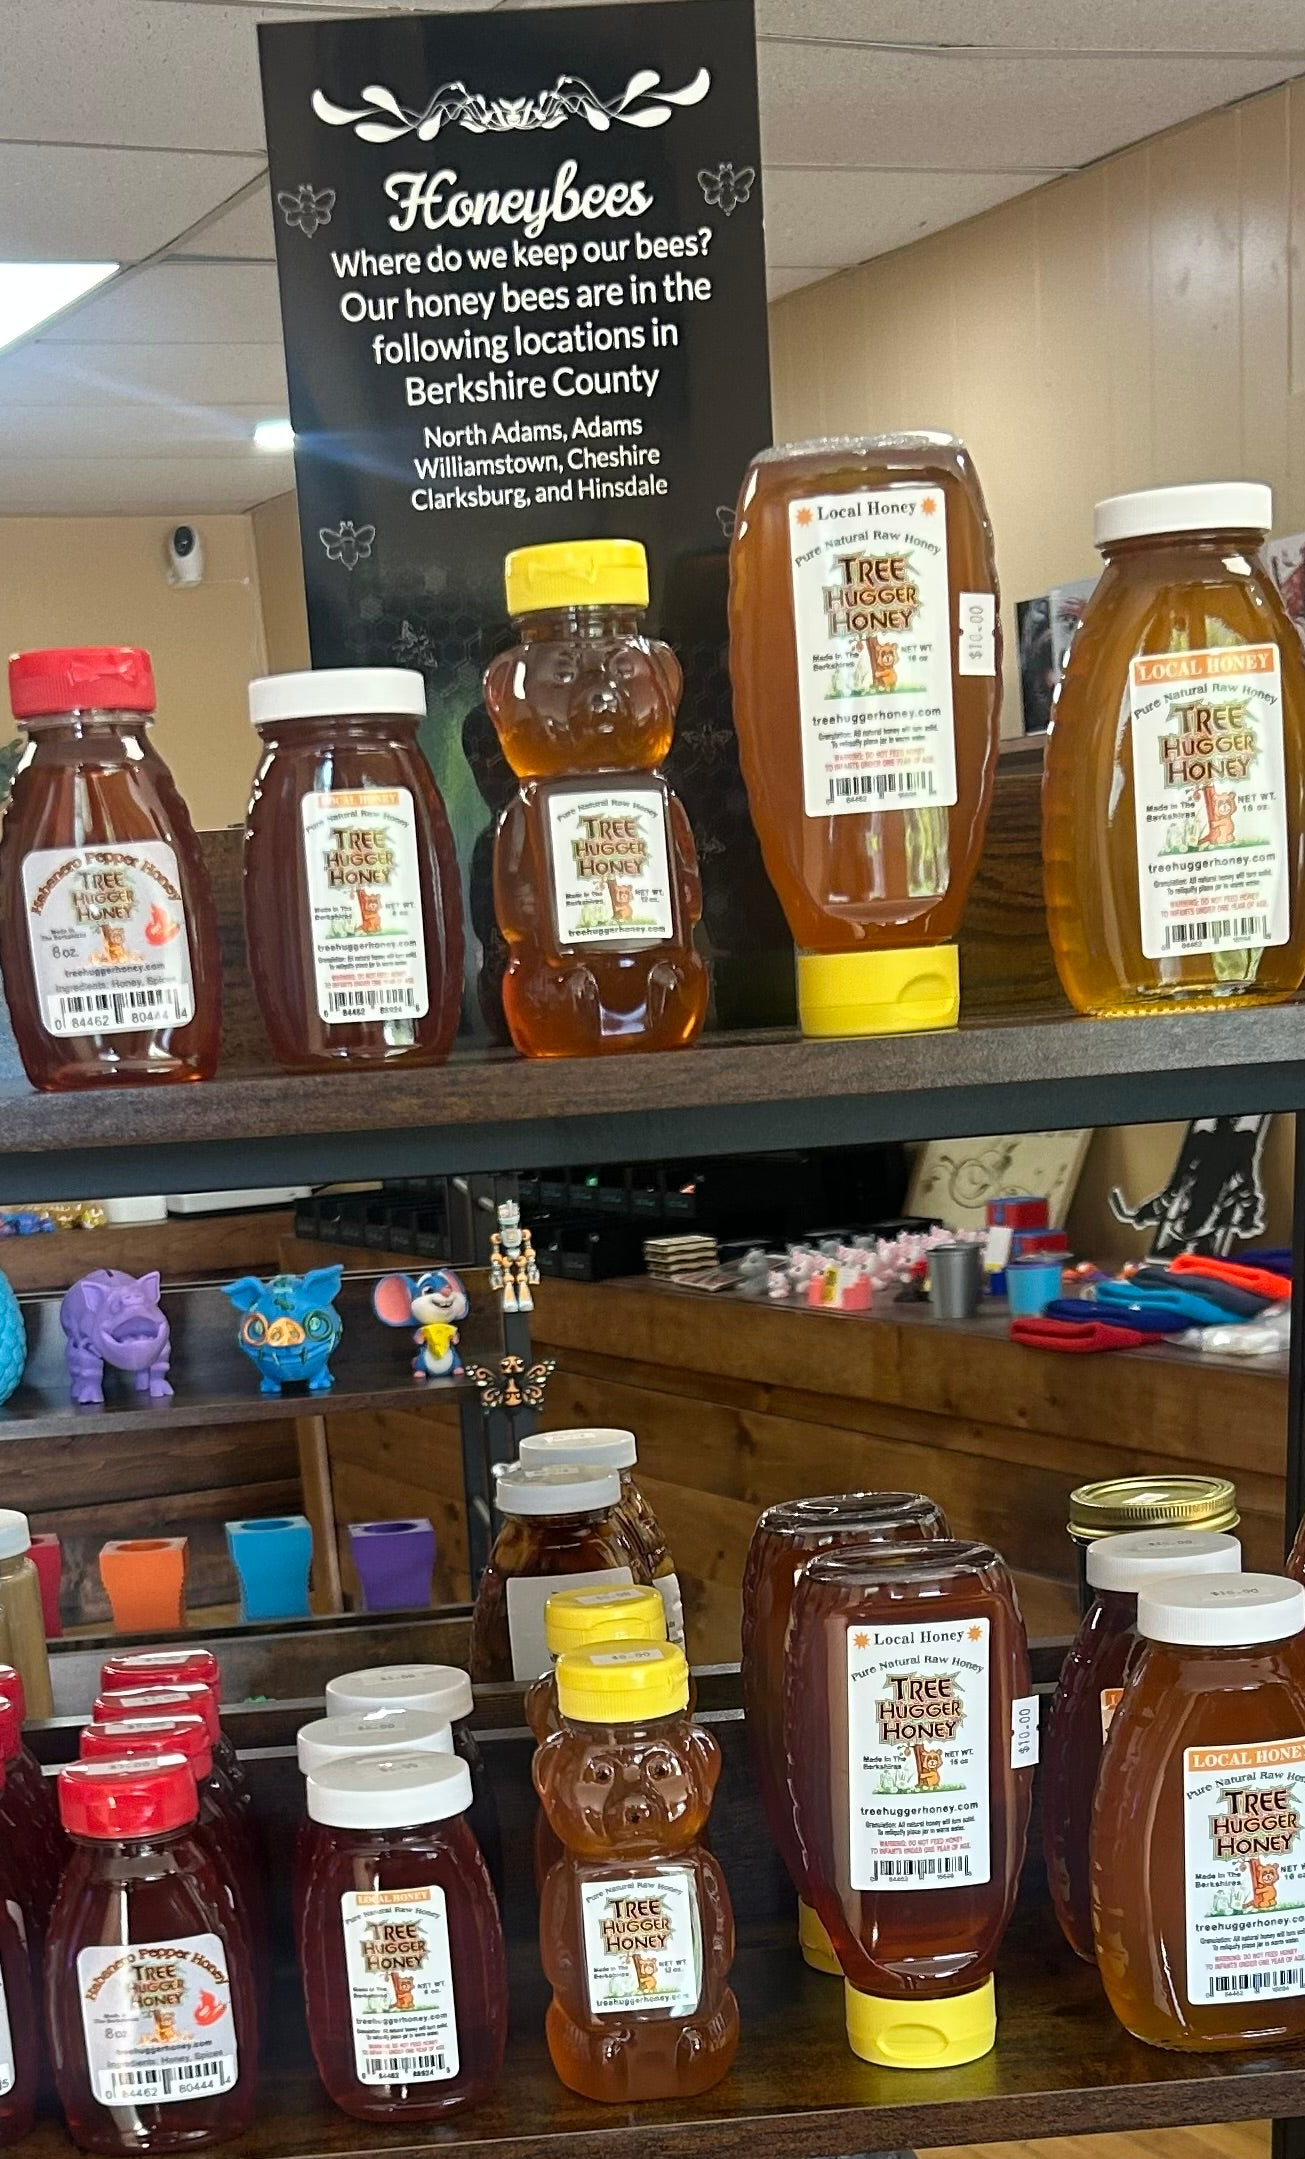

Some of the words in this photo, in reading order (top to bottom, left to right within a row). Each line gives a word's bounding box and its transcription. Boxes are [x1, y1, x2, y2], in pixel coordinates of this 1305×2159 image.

[383, 158, 653, 239] Honeybees
[331, 247, 421, 280] Where
[427, 245, 463, 273] do
[467, 247, 507, 270] we
[513, 238, 577, 270] keep
[582, 238, 630, 263] our
[634, 227, 713, 259] bees?
[340, 292, 399, 323] Our
[405, 287, 495, 321] honey
[503, 282, 570, 312] bees
[575, 282, 623, 307] are
[629, 276, 657, 304] in
[663, 273, 712, 301] the
[372, 329, 509, 365] following
[514, 322, 645, 355] locations
[651, 318, 679, 346] in
[405, 371, 547, 406] Berkshire
[552, 365, 659, 398] County
[423, 424, 488, 448] North
[491, 419, 568, 444] Adams,
[572, 415, 643, 438] Adams
[414, 451, 564, 479] Williamstown,
[567, 446, 660, 470] Cheshire
[411, 485, 532, 511] Clarksburg,
[535, 480, 573, 503] and
[578, 476, 668, 500] Hinsdale
[818, 502, 862, 521] Local
[868, 501, 917, 516] Honey
[795, 547, 822, 568] Pure
[825, 530, 869, 550] Natural
[873, 530, 901, 541] Raw
[904, 533, 942, 555] Honey
[838, 557, 905, 586] TREE
[828, 587, 917, 610] HUGGER
[833, 611, 913, 633] HONEY
[969, 605, 984, 659] $10.00
[1139, 660, 1202, 681] LOCAL
[1207, 653, 1270, 673] HONEY
[1134, 700, 1161, 720] Pure
[1164, 683, 1208, 703] Natural
[1212, 683, 1238, 693] Raw
[1242, 685, 1278, 706] Honey
[812, 708, 941, 726] treehuggerhoney.com
[1175, 705, 1243, 735] TREE
[1164, 734, 1254, 758] HUGGER
[1169, 759, 1251, 783] HONEY
[584, 819, 637, 839] TREE
[332, 829, 385, 852] TREE
[576, 842, 645, 857] HUGGER
[326, 851, 393, 867] HUGGER
[579, 860, 644, 877] HONEY
[1148, 852, 1276, 873] treehuggerhoney.com
[31, 858, 82, 916] Habanero
[85, 852, 139, 867] Pepper
[141, 860, 182, 901] Honey
[79, 872, 124, 890] TREE
[330, 869, 390, 887] HONEY
[72, 891, 135, 906] HUGGER
[77, 907, 133, 922] HONEY
[52, 947, 61, 958] 8
[72, 1015, 109, 1029] 84462
[131, 1012, 169, 1024] 80444
[181, 1009, 188, 1018] 4
[874, 1632, 915, 1646] Local
[920, 1630, 965, 1643] Honey
[851, 1666, 877, 1682] Pure
[879, 1655, 920, 1671] Natural
[924, 1655, 949, 1663] Raw
[952, 1657, 985, 1674] Honey
[890, 1676, 951, 1702] TREE
[879, 1702, 961, 1720] HUGGER
[883, 1721, 957, 1740] HONEY
[1018, 1708, 1032, 1754] $10.00
[1192, 1752, 1251, 1768] LOCAL
[1187, 1784, 1212, 1799] Pure
[1215, 1772, 1256, 1788] Natural
[1287, 1772, 1305, 1783] Hon
[861, 1802, 979, 1817] treehuggerhoney.com
[1225, 1790, 1287, 1816] TREE
[1213, 1814, 1297, 1835] HUGGER
[1217, 1834, 1293, 1856] HONEY
[393, 1890, 430, 1902] HONEY
[586, 1891, 603, 1903] Pure
[605, 1882, 634, 1894] Natural
[657, 1883, 684, 1896] Honey
[415, 1908, 441, 1919] Honey
[610, 1900, 662, 1919] TREE
[370, 1924, 417, 1942] TREE
[603, 1919, 670, 1935] HUGGER
[1195, 1916, 1305, 1931] treehuggerhoney.co
[363, 1941, 426, 1956] HUGGER
[606, 1935, 667, 1952] HONEY
[133, 1965, 177, 1981] TREE
[367, 1955, 423, 1971] HONEY
[85, 1954, 136, 2001] Habanero
[138, 1948, 191, 1959] Pepper
[191, 1952, 230, 1985] Honey
[105, 2028, 113, 2039] 8
[105, 2091, 112, 2099] 0
[179, 2080, 214, 2093] 80444
